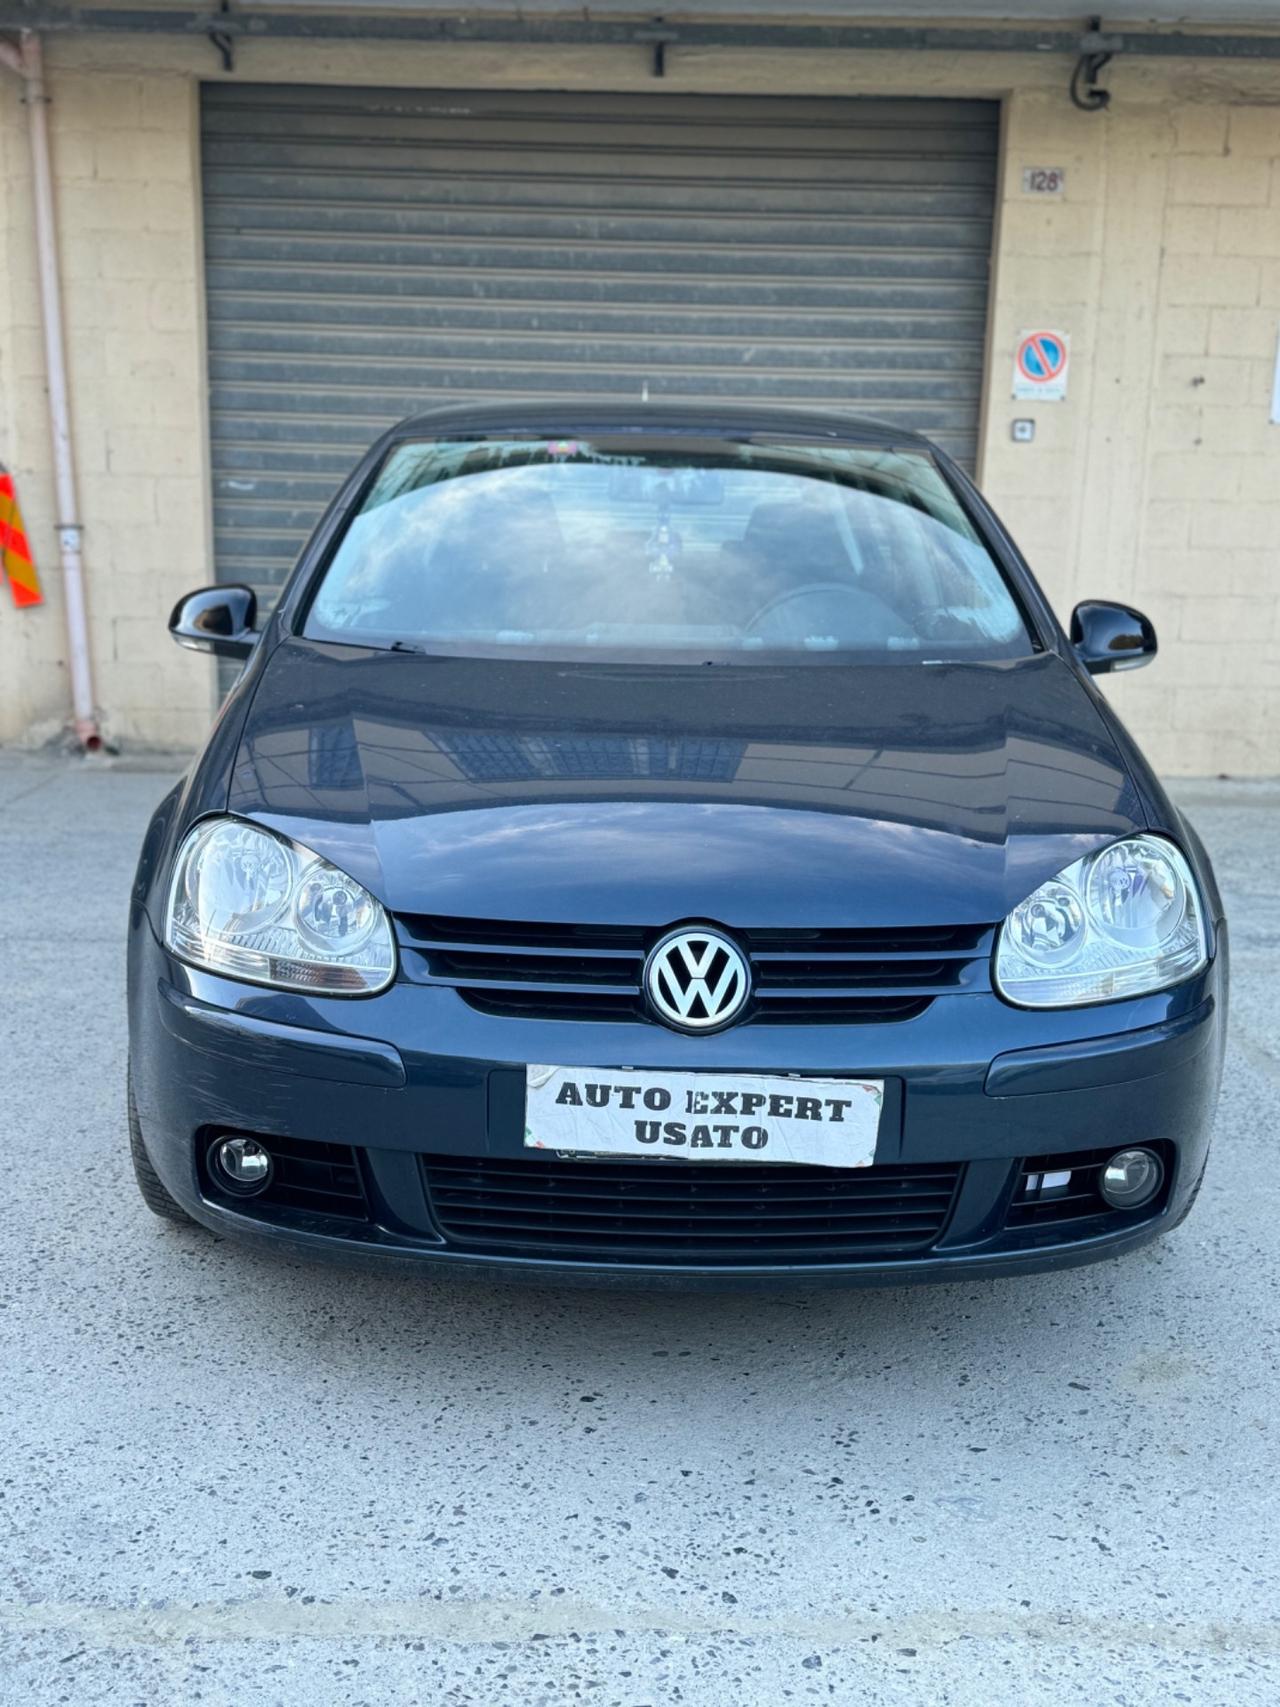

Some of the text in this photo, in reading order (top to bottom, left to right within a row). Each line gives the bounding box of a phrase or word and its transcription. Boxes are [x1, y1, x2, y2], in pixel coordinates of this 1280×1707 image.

[555, 1081, 852, 1122] AUTO EXPERT
[634, 1120, 769, 1149] USATO
